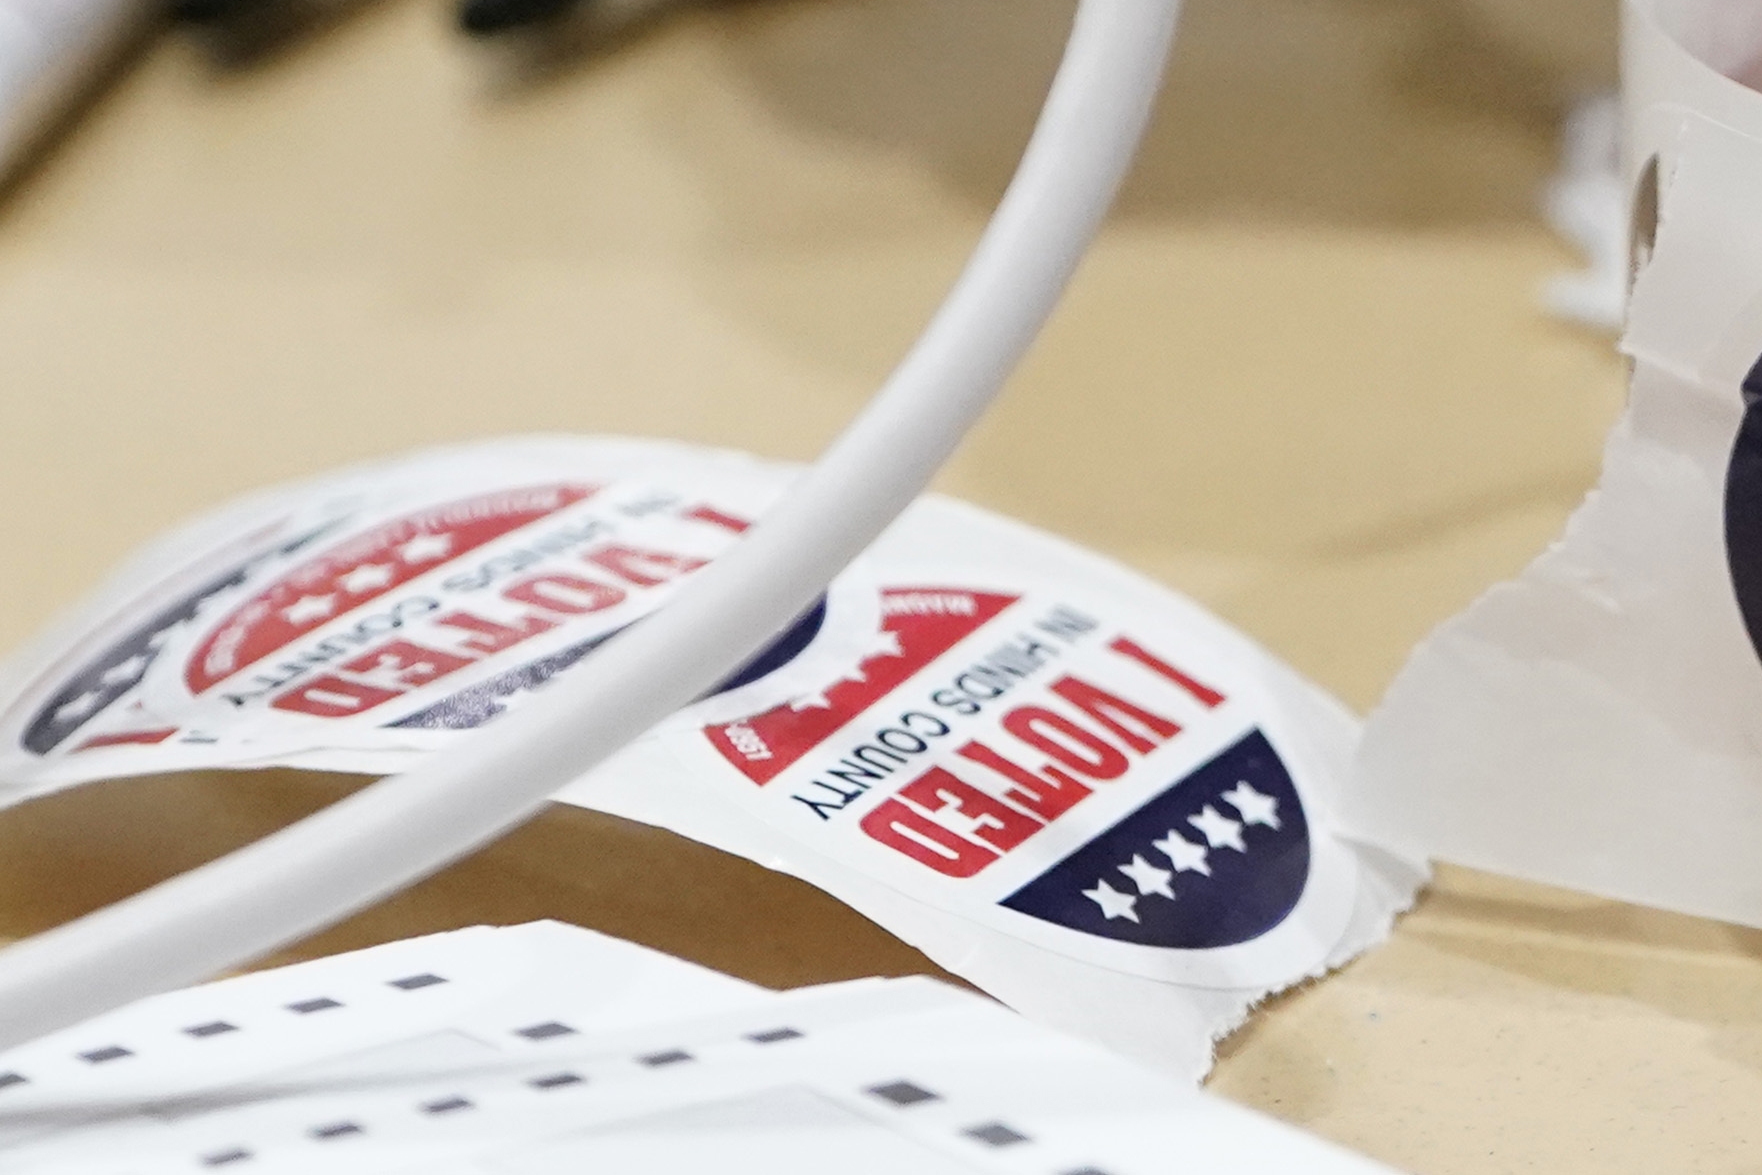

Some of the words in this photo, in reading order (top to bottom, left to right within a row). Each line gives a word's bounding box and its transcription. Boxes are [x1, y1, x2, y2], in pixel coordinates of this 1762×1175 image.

[267, 543, 716, 719] VOTED
[930, 630, 1060, 717] HINDS
[1105, 635, 1229, 711] I
[789, 711, 952, 821] COUNTY
[859, 673, 1184, 879] VOTED
